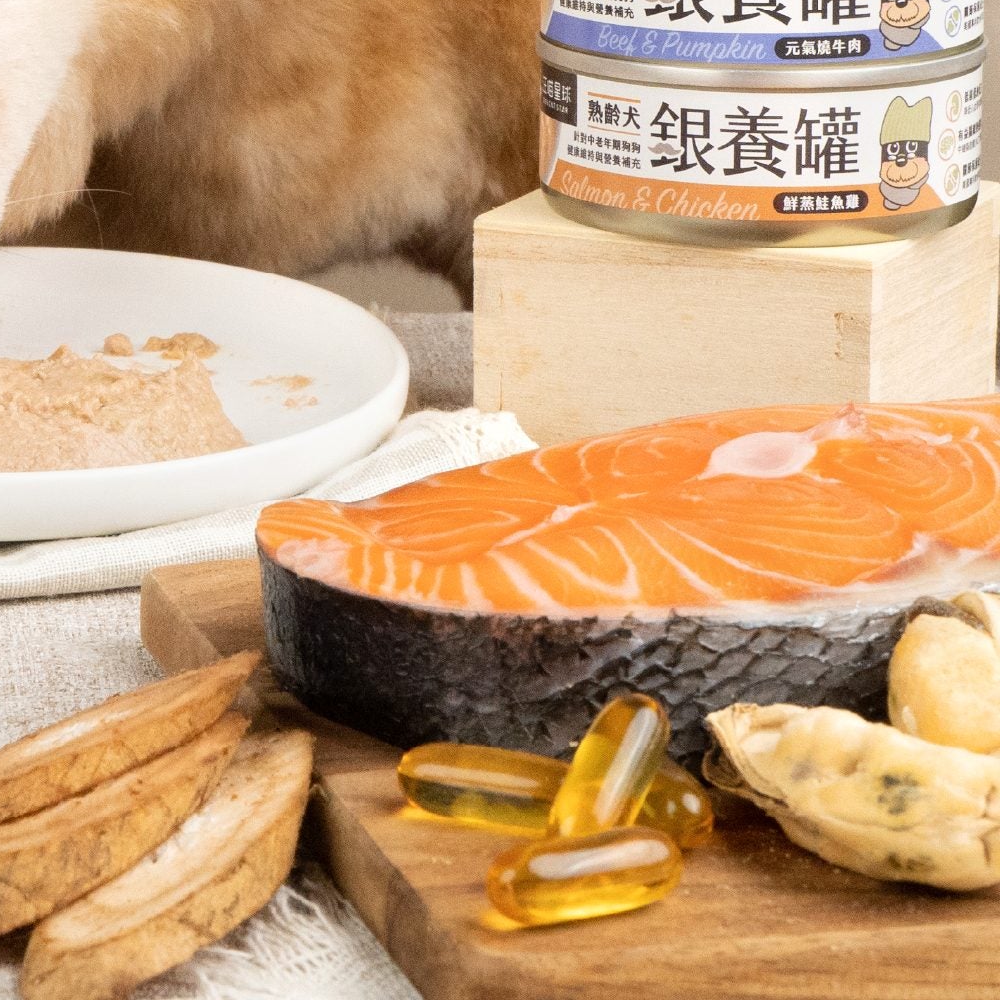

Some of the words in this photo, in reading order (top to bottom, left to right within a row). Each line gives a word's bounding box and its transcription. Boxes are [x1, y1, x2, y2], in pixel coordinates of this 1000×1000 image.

[597, 25, 638, 57] Beef
[641, 31, 659, 55] &
[661, 31, 767, 63] Pumpkin
[784, 37, 862, 57] 元氣燒牛肉
[587, 99, 641, 130] 熟齡犬
[573, 130, 641, 154] 針對中老年期狗狗
[648, 101, 861, 179] 銀養罐
[560, 170, 630, 209] Salmon
[632, 186, 652, 212] &
[656, 188, 760, 221] Chicken
[783, 194, 860, 212] 鮮蒸鮭魚雞
